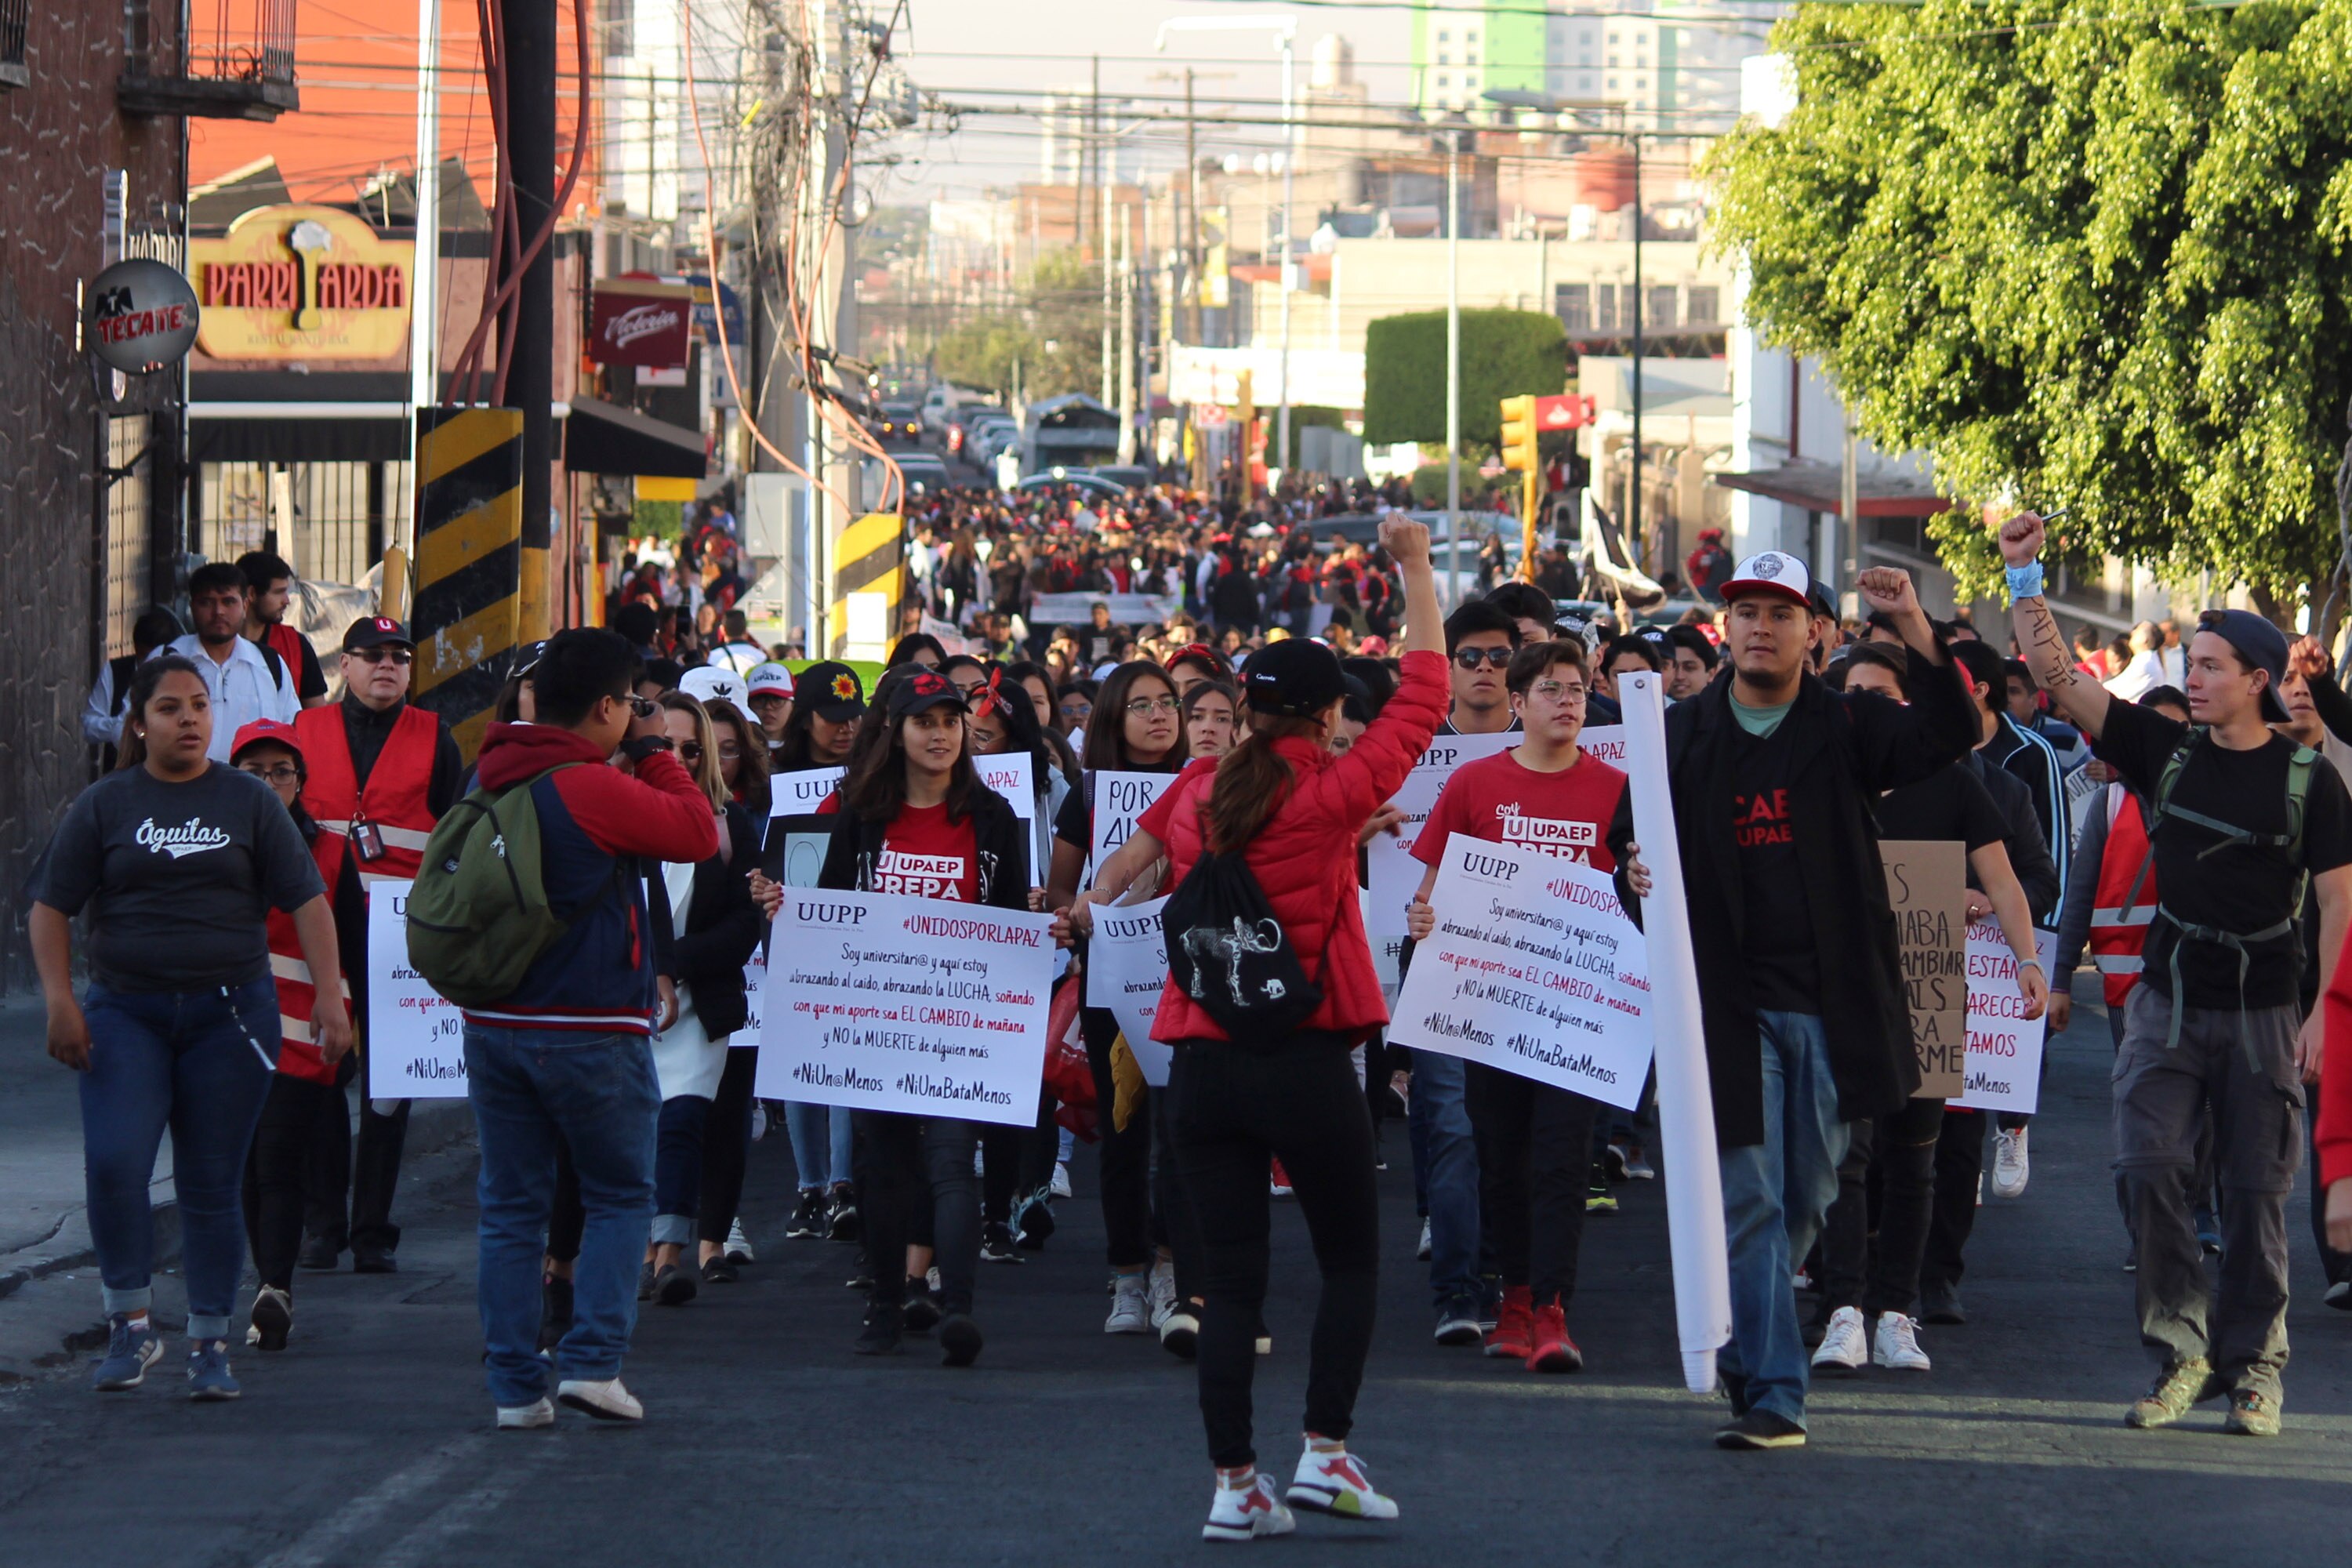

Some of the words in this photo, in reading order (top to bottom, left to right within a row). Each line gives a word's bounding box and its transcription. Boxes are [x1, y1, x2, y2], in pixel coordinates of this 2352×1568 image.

[96, 303, 186, 345] TECATE
[1109, 780, 1153, 812] POR
[1495, 801, 1520, 820] Soy
[136, 818, 223, 854] Águilas
[1534, 821, 1593, 841] UPAEP
[901, 858, 959, 873] UPAEP
[1464, 852, 1519, 880] UUPP
[798, 902, 866, 924] UUPP
[1490, 898, 1504, 922] Soy
[1505, 906, 1564, 931] universitari@
[1562, 925, 1572, 940] y
[1573, 927, 1595, 946] aquí
[1596, 934, 1618, 955] estoy
[903, 915, 1040, 947] #UNIDOSPORLAPAZ
[841, 942, 860, 967] Soy
[863, 951, 927, 966] universitari@
[930, 958, 937, 974] y
[940, 959, 961, 976] aquí
[963, 959, 987, 978] estoy
[1442, 919, 1482, 940] abrazando
[1483, 927, 1492, 942] al
[1515, 938, 1562, 961] abrazando
[1564, 948, 1572, 964] la
[1575, 953, 1615, 980] LUCHA,
[1618, 972, 1650, 992] soñando
[789, 969, 839, 986] abrazando
[842, 972, 851, 988] al
[883, 977, 932, 996] abrazando
[936, 981, 944, 996] la
[948, 982, 991, 1003] LUCHA,
[996, 989, 1034, 1005] soñando
[1439, 952, 1454, 964] con
[1454, 956, 1468, 971] que
[1469, 959, 1479, 968] mi
[1480, 961, 1506, 976] aporte
[1508, 967, 1522, 978] sea
[1526, 966, 1539, 984] EL
[1543, 971, 1593, 1000] CAMBIO
[1593, 988, 1604, 1004] de
[1607, 995, 1641, 1017] mañana
[399, 997, 416, 1008] con
[419, 997, 436, 1014] que
[793, 1002, 810, 1012] con
[813, 1004, 829, 1020] que
[834, 1004, 846, 1015] mi
[848, 1006, 879, 1023] aporte
[883, 1010, 897, 1020] sea
[902, 1005, 916, 1022] EL
[920, 1007, 970, 1027] CAMBIO
[973, 1013, 983, 1029] de
[987, 1018, 1025, 1033] mañana
[1139, 1006, 1156, 1018] con
[1452, 985, 1461, 1000] y
[1462, 979, 1477, 996] NO
[1476, 982, 1484, 998] la
[1486, 985, 1536, 1011] MUERTE
[1536, 1000, 1547, 1016] de
[1549, 1005, 1582, 1029] alguien
[1584, 1021, 1604, 1034] más
[430, 1025, 438, 1043] y
[441, 1018, 458, 1036] NO
[822, 1033, 829, 1048] y
[833, 1027, 849, 1044] NO
[853, 1029, 860, 1045] la
[865, 1030, 916, 1051] MUERTE
[919, 1037, 929, 1052] de
[932, 1038, 965, 1062] alguien
[969, 1045, 989, 1058] más
[1424, 1012, 1494, 1046] #NiUn@Menos
[1506, 1033, 1617, 1084] #NiUnaBataMenos
[793, 1062, 883, 1091] #NiUn@Menos
[897, 1073, 1011, 1105] #NiUnaBataMenos
